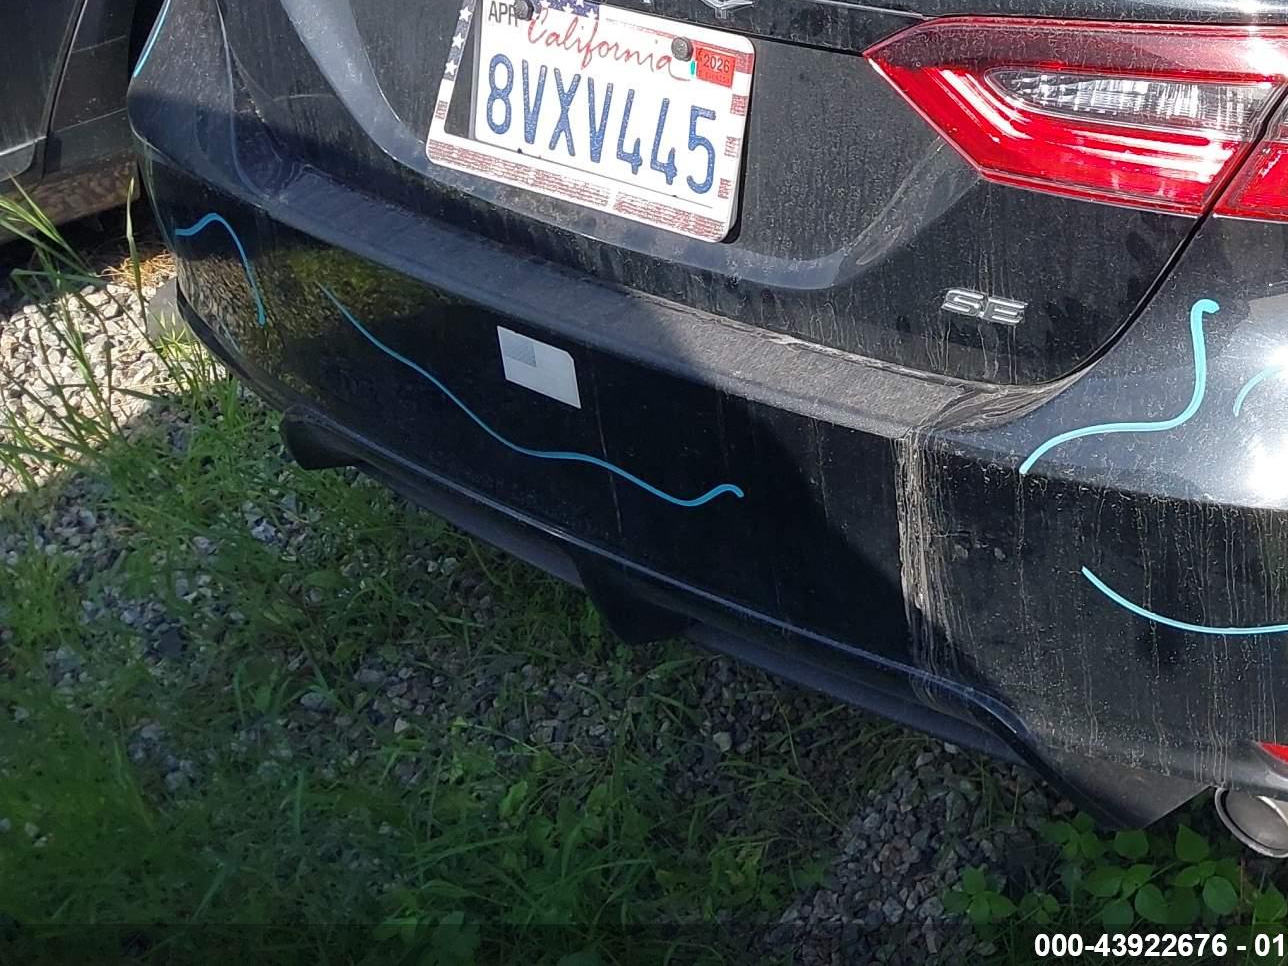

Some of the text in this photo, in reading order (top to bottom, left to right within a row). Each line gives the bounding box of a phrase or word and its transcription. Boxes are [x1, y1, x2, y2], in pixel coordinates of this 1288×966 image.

[528, 7, 691, 82] California
[703, 53, 730, 74] 2026
[486, 53, 717, 195] 8VXV445
[941, 288, 1027, 325] SE
